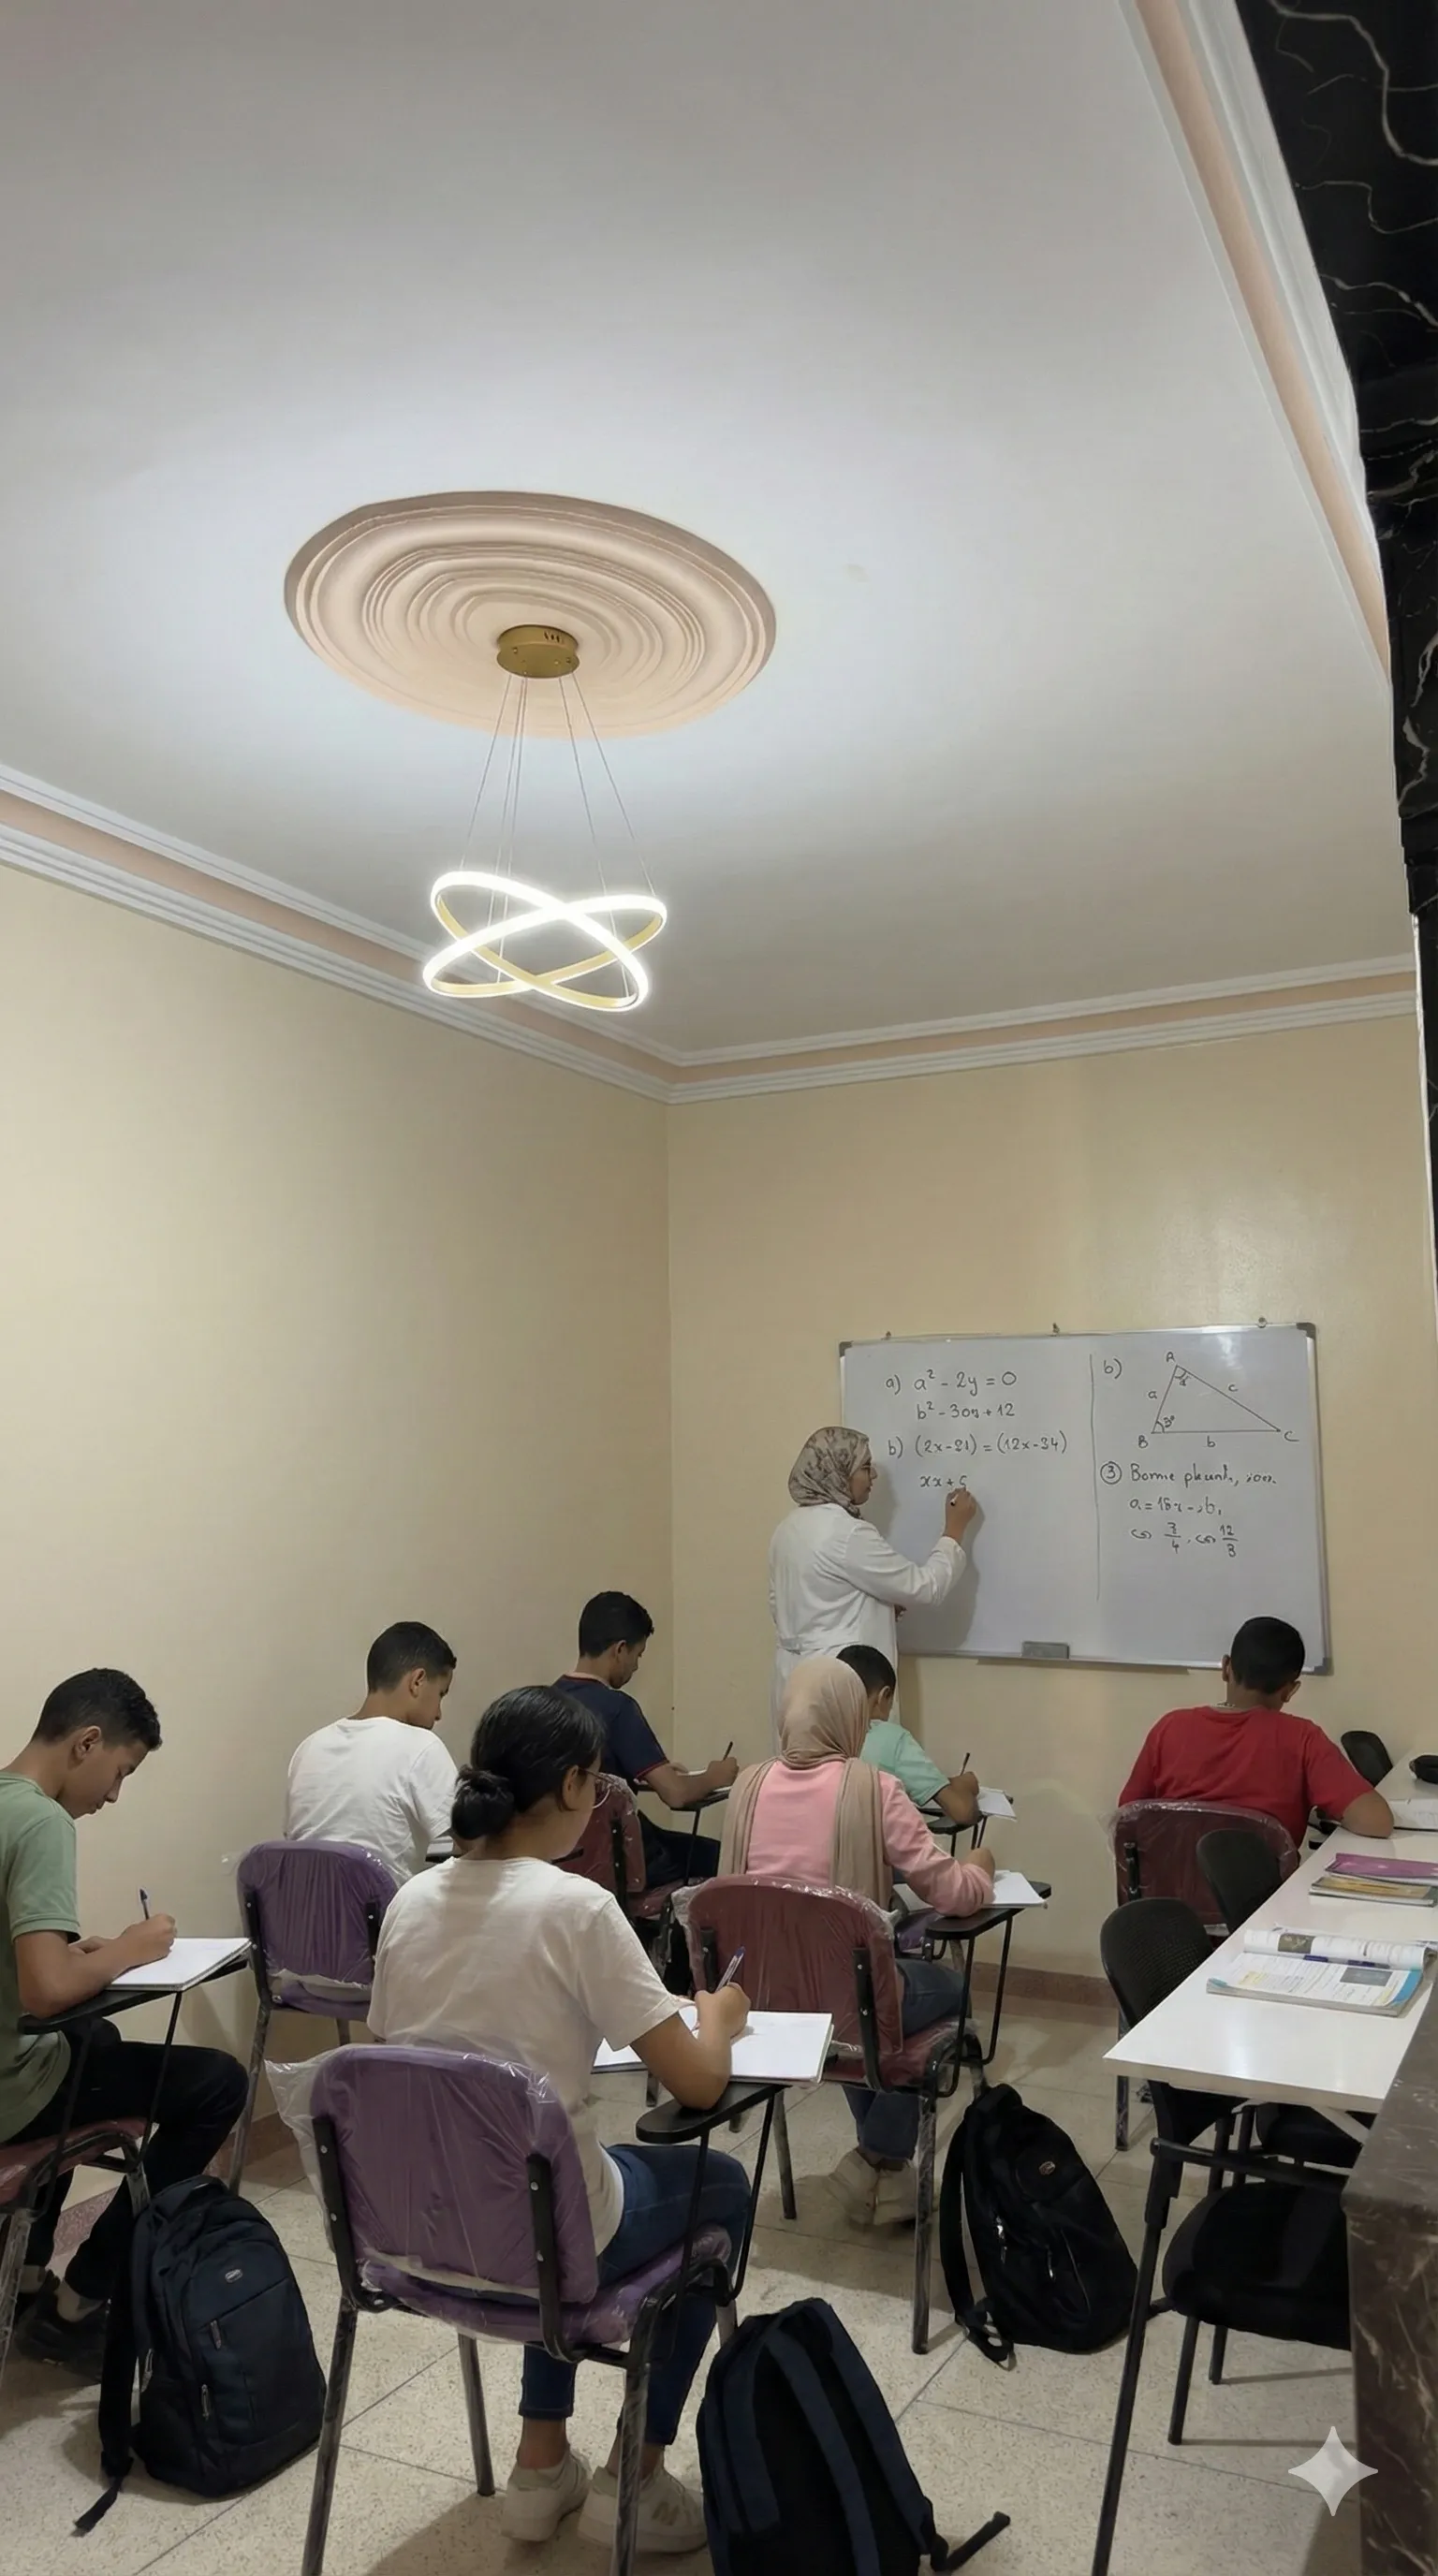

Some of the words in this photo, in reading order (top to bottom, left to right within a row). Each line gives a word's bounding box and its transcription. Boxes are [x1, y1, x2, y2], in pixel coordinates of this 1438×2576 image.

[1103, 1357, 1123, 1380] b)
[1166, 1351, 1176, 1363] A
[885, 1374, 902, 1396] a)
[956, 1370, 978, 1397] 2y
[888, 1435, 903, 1459] b)
